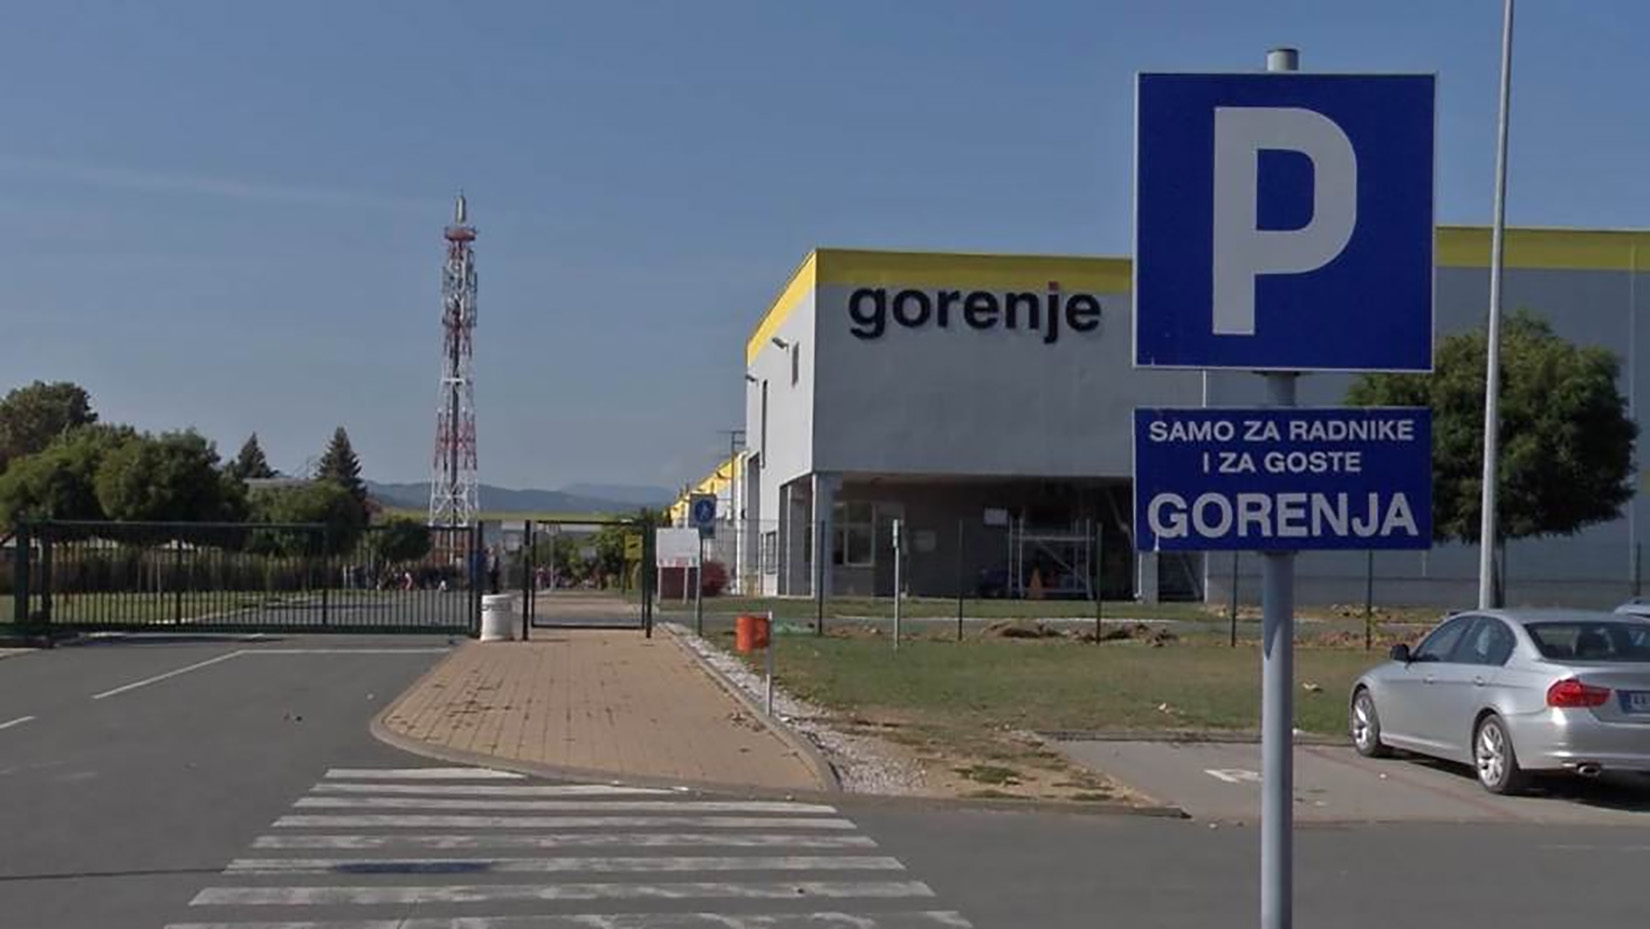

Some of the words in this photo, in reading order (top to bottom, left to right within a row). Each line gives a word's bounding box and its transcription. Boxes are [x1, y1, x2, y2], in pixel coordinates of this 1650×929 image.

[1212, 106, 1357, 335] P
[848, 281, 1101, 344] gorenje
[1150, 420, 1235, 442] SAMO
[1243, 420, 1281, 441] ZA
[1289, 419, 1414, 441] RADNIKE
[1203, 452, 1210, 473] I
[1218, 451, 1257, 473] ZA
[1264, 451, 1362, 473] GOSTE
[1147, 492, 1419, 538] GORENJA
